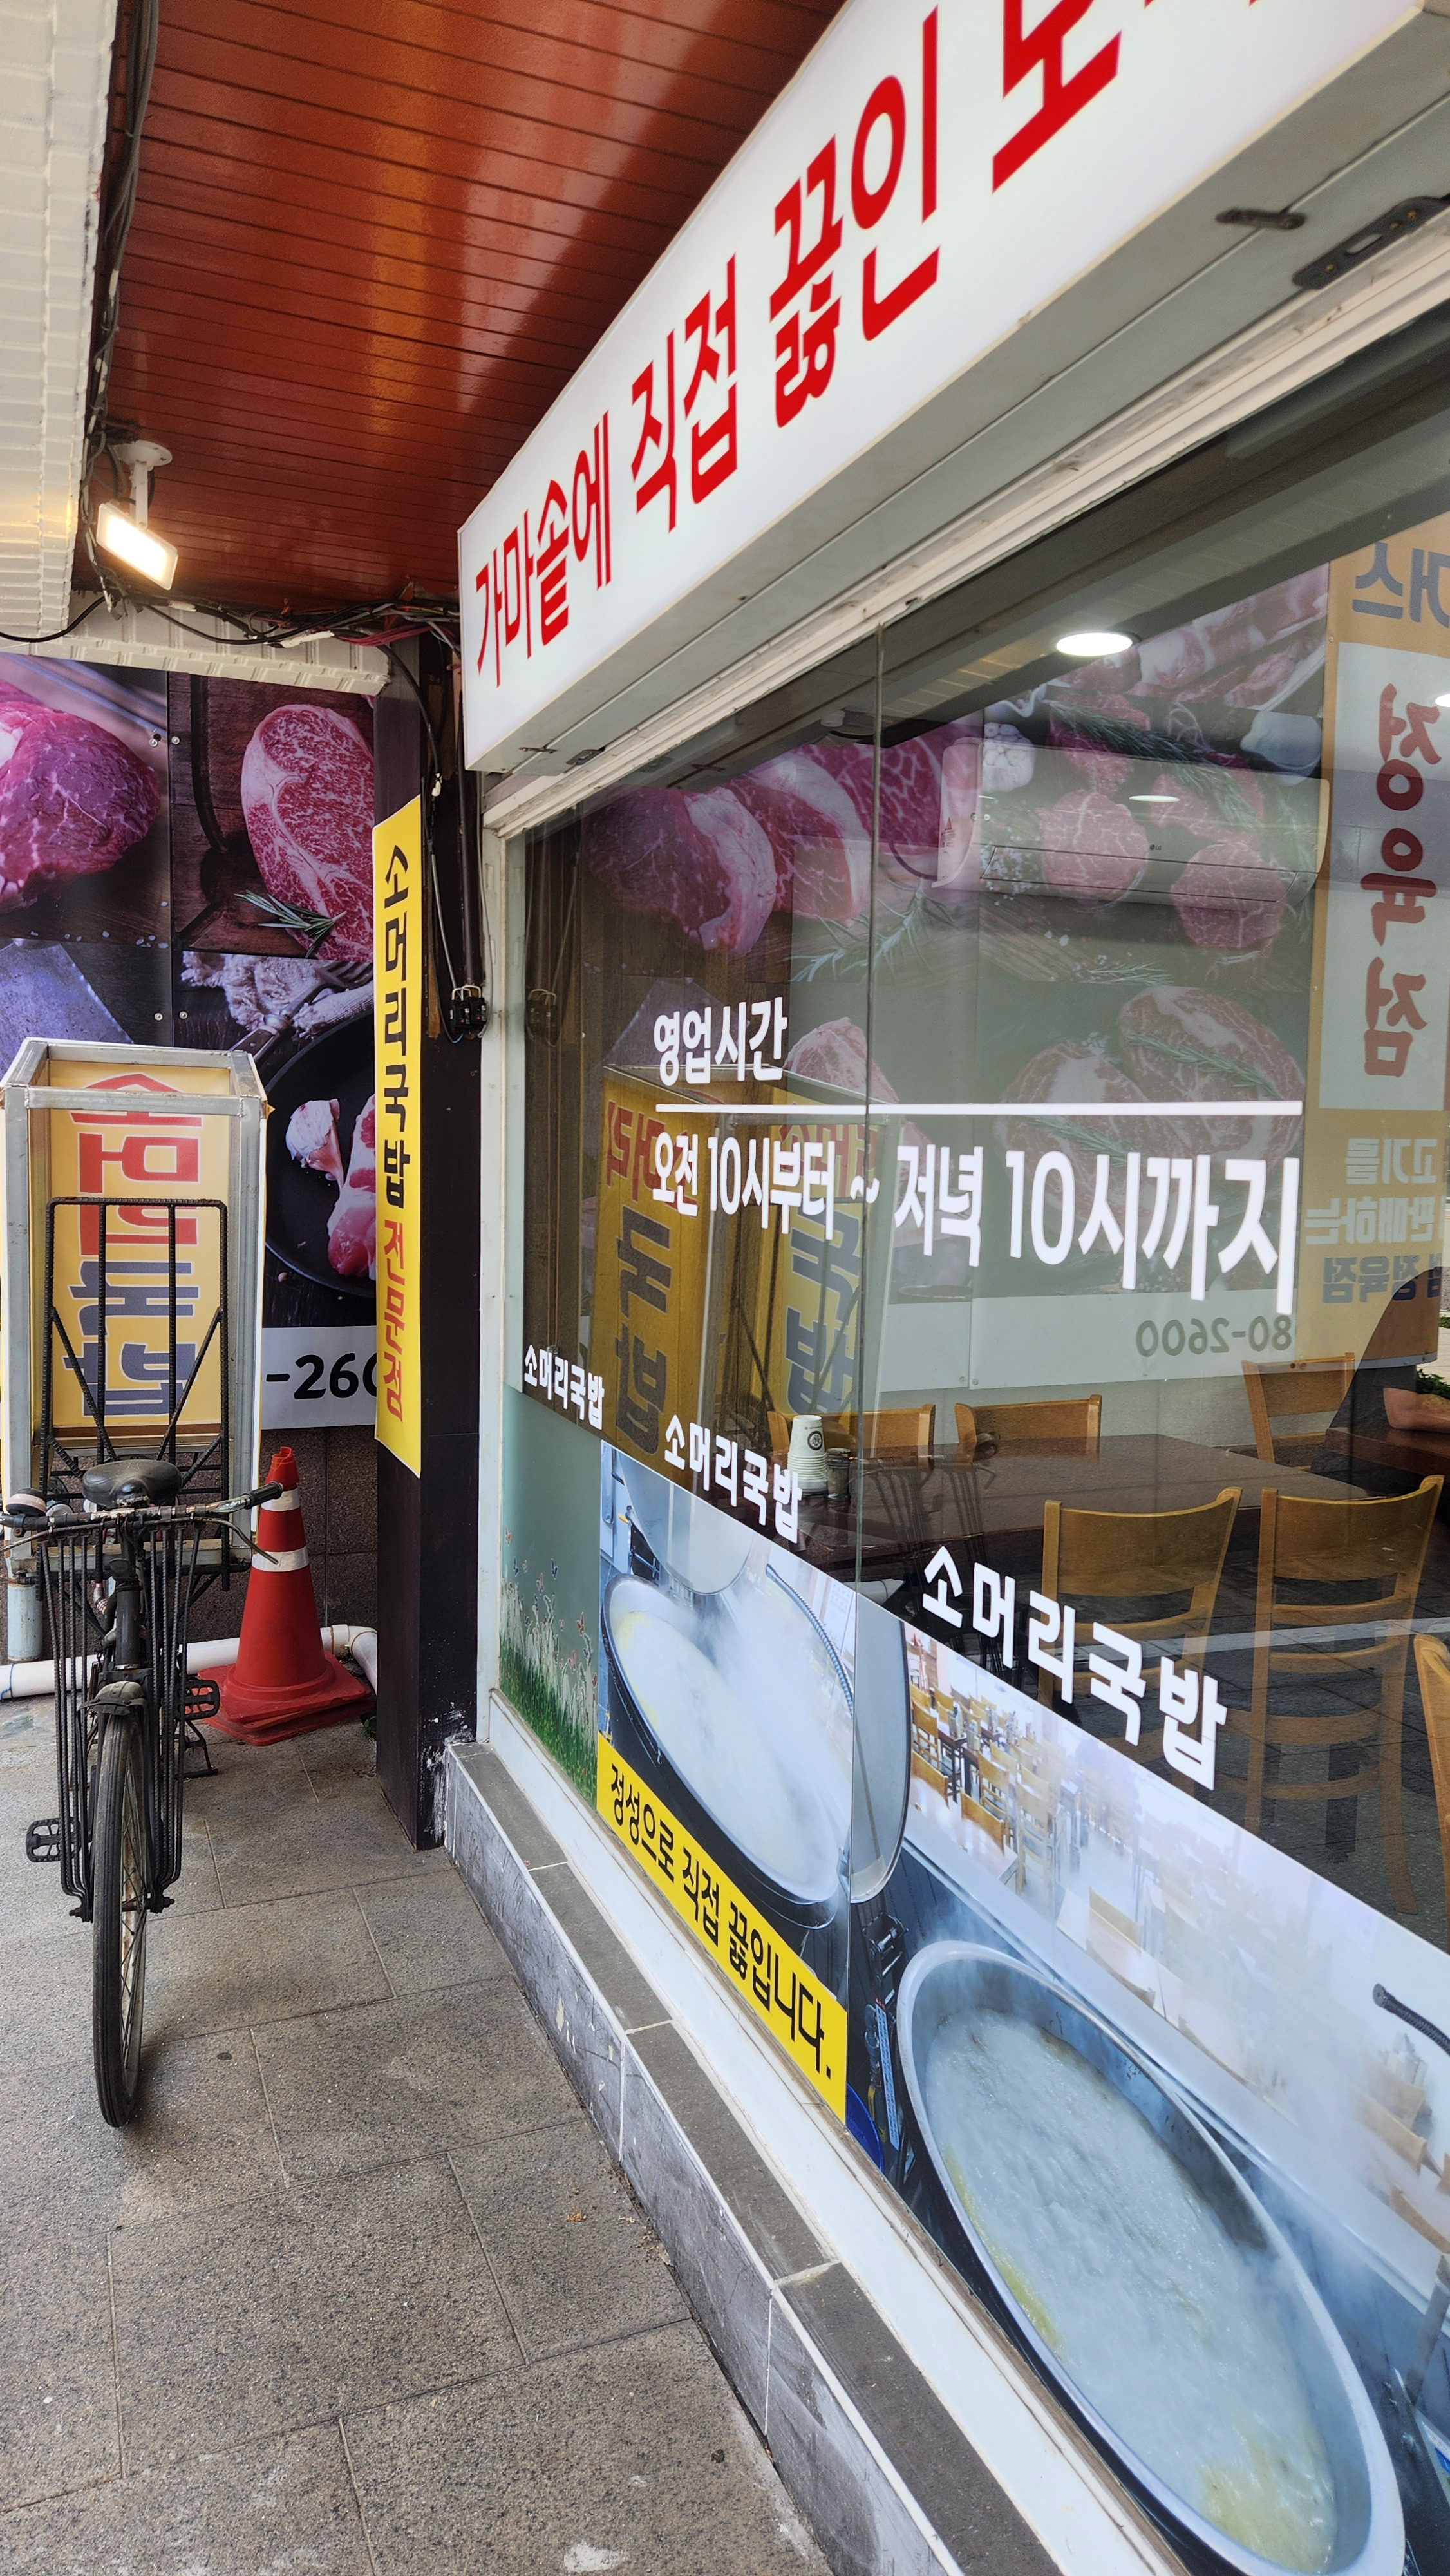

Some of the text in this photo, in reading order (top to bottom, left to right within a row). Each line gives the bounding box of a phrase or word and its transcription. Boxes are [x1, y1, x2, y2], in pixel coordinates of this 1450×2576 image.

[475, 8, 939, 687] 가마솥에 직접 끓인
[384, 844, 411, 1423] 소머리국밥 전문점
[653, 997, 788, 1086] 영업시간
[652, 1132, 699, 1217] 오전
[708, 1137, 835, 1240] 10시부터
[894, 1144, 983, 1267] 저녁
[1006, 1151, 1299, 1316] 10시까지
[524, 1344, 605, 1430] 소머리국밥
[664, 1414, 803, 1544] 소머리국밥
[923, 1546, 1228, 1790] 소머리국밥
[610, 1763, 831, 2080] 정성으로 직접 끓입니다.
